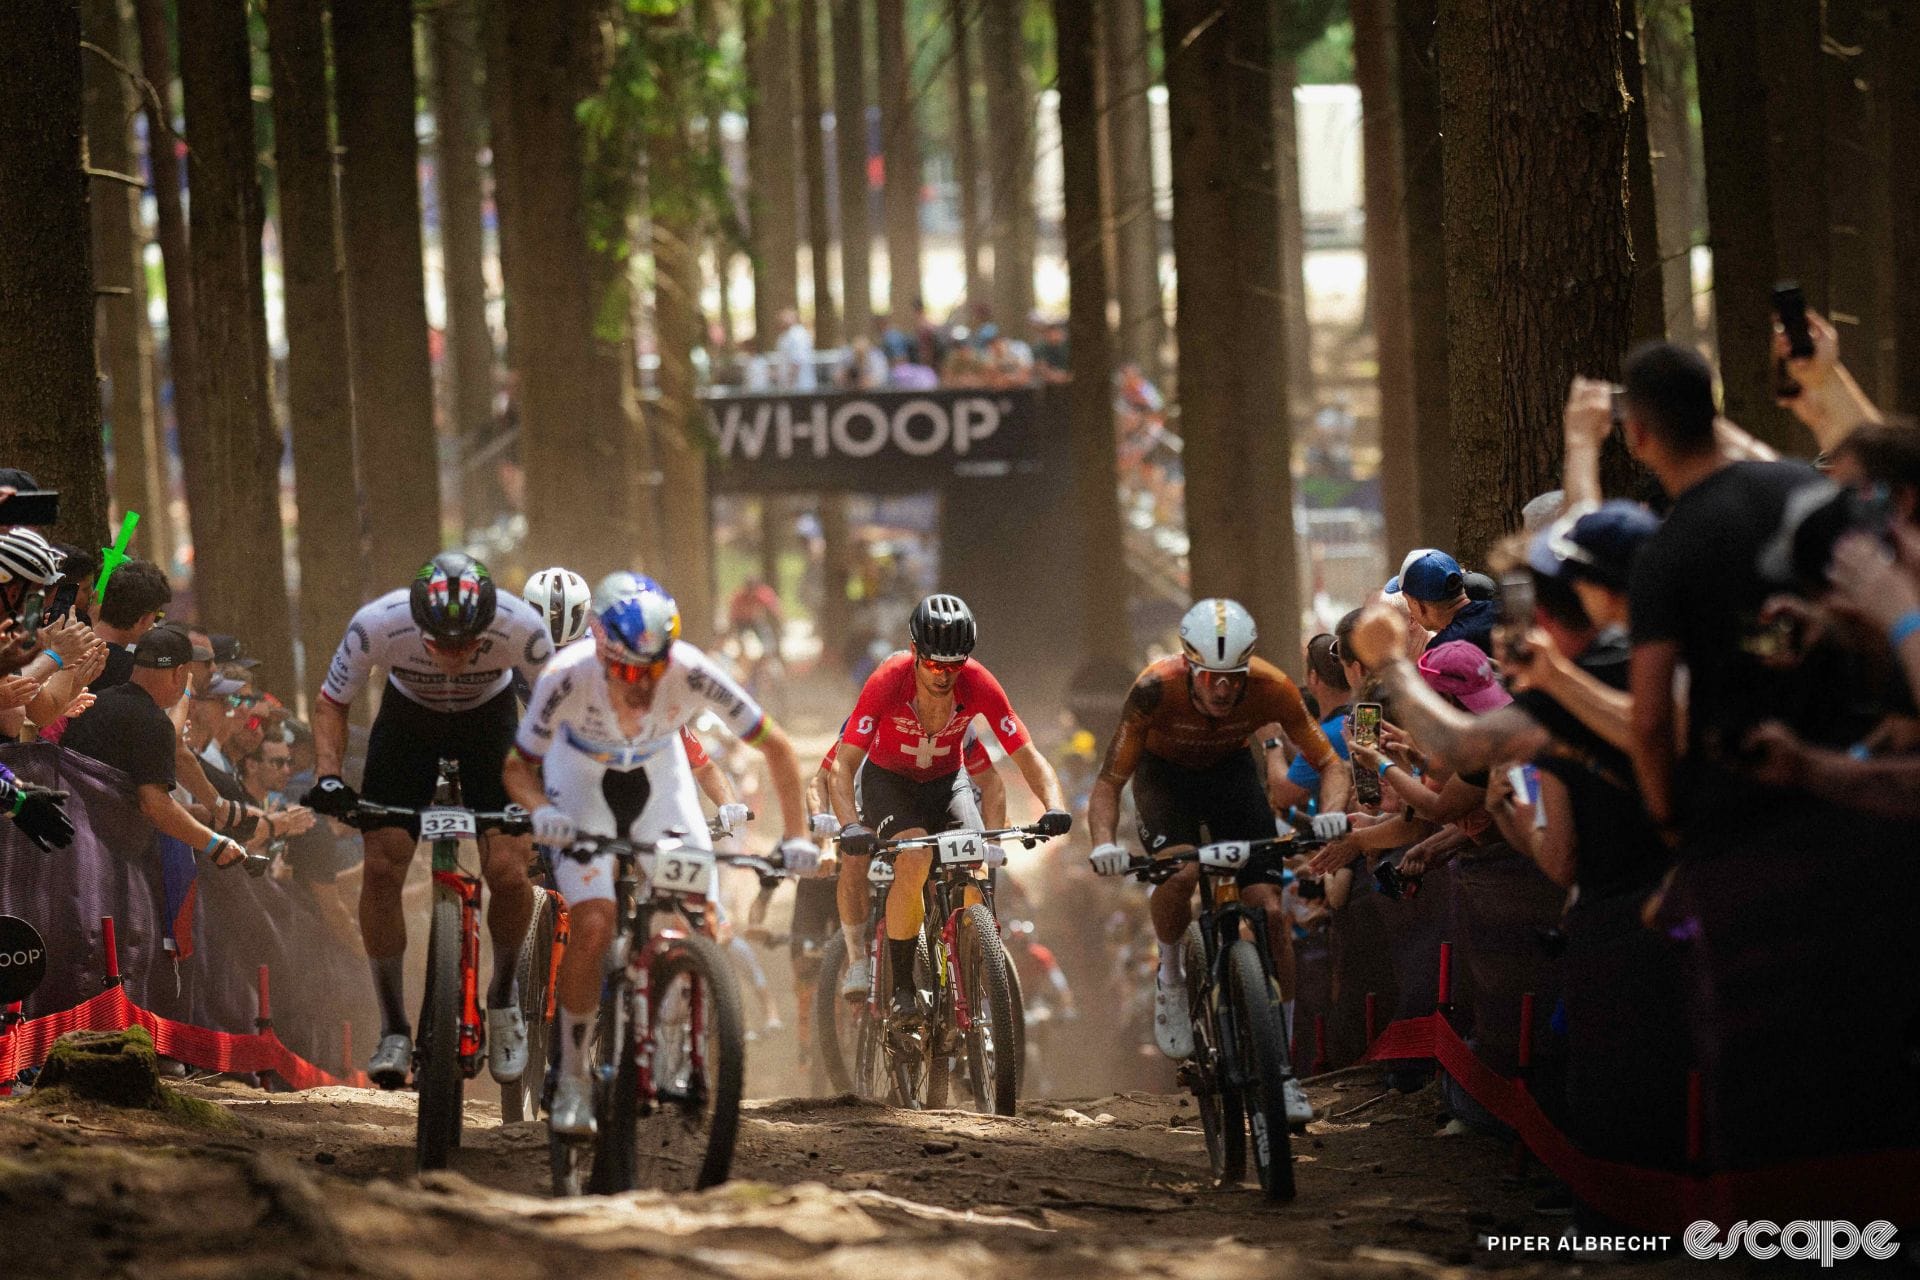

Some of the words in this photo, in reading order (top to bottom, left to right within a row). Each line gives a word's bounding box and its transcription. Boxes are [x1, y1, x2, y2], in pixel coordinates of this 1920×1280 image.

[706, 399, 1000, 459] WHOOP
[425, 818, 469, 832] 321
[948, 839, 977, 857] 14
[1209, 846, 1241, 863] 13
[665, 859, 703, 883] 37
